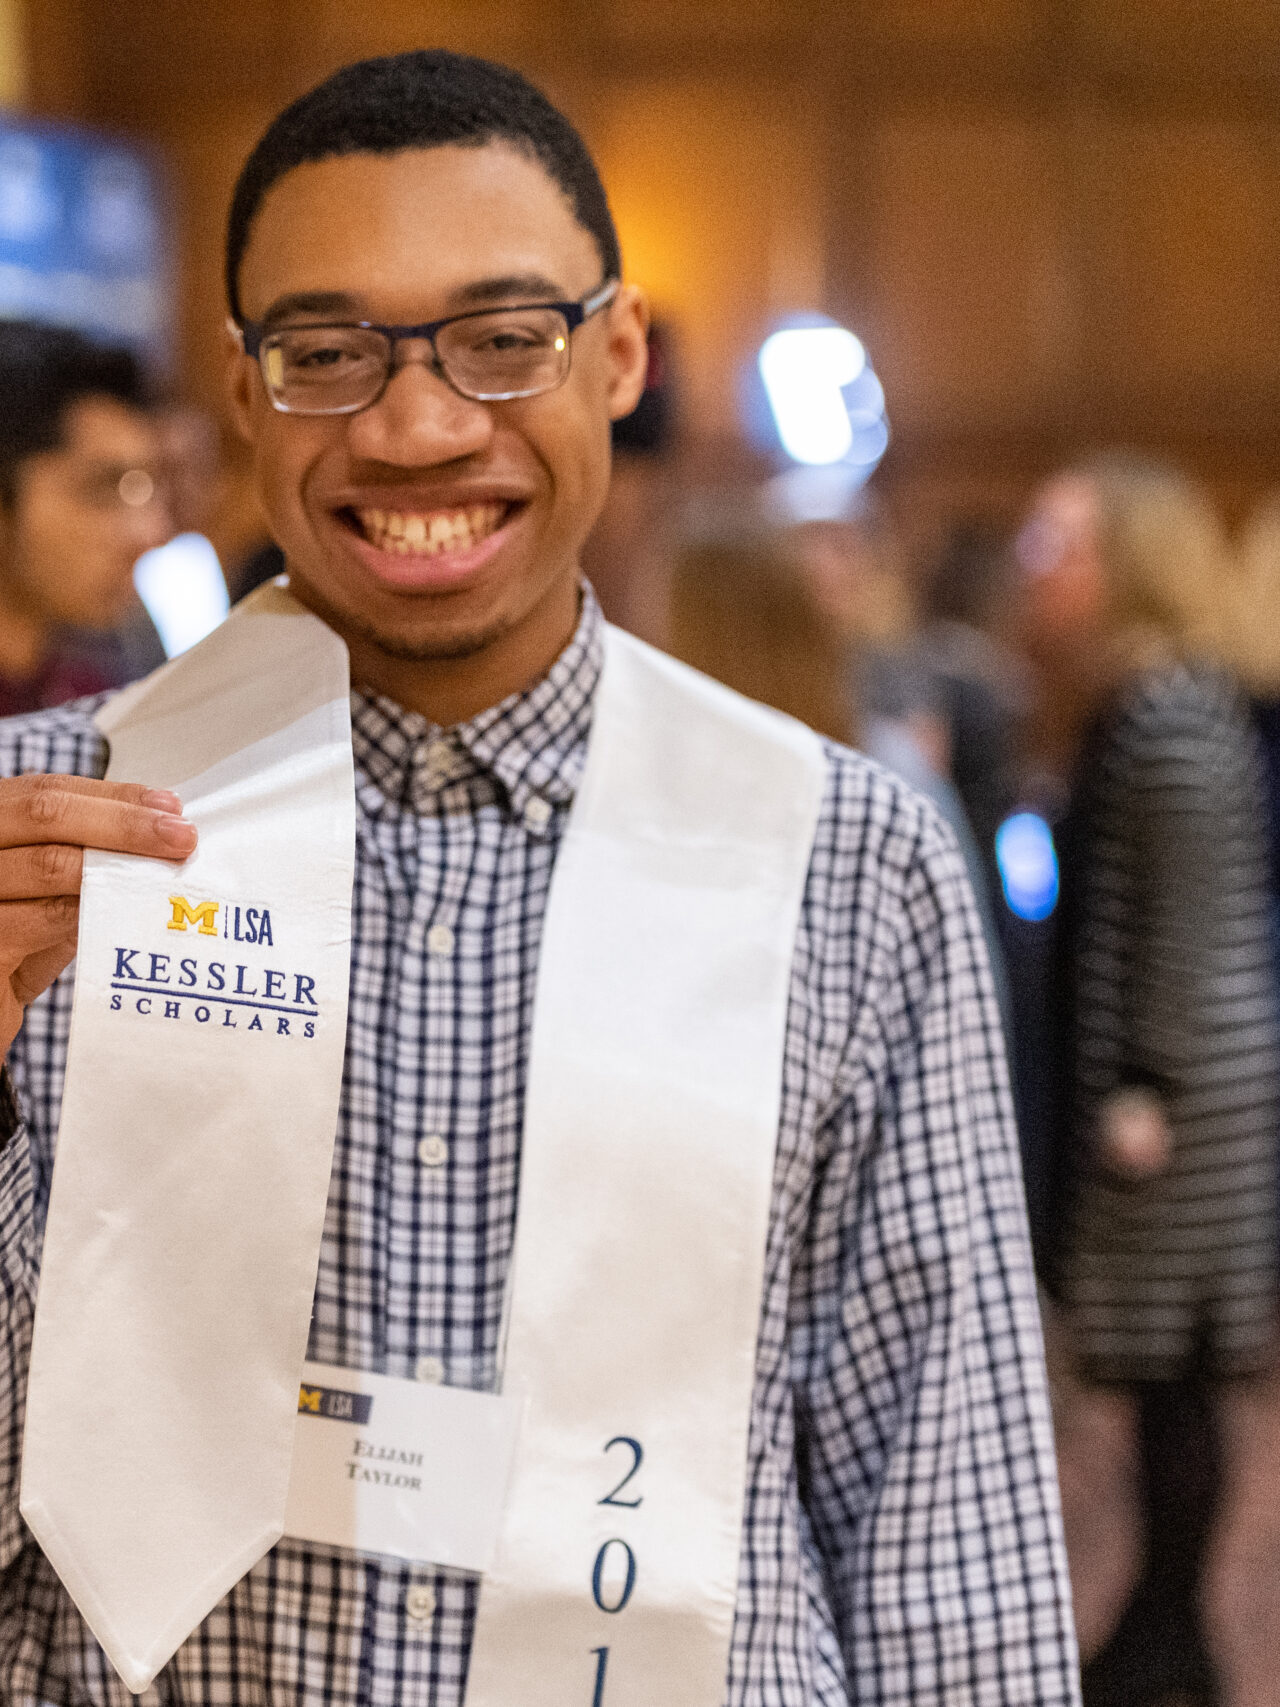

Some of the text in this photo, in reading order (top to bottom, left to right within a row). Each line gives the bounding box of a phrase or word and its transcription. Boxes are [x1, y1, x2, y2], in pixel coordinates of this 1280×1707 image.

[167, 896, 273, 946] M LSA
[112, 947, 318, 1005] KESSLER
[110, 995, 316, 1038] SCHOLARS
